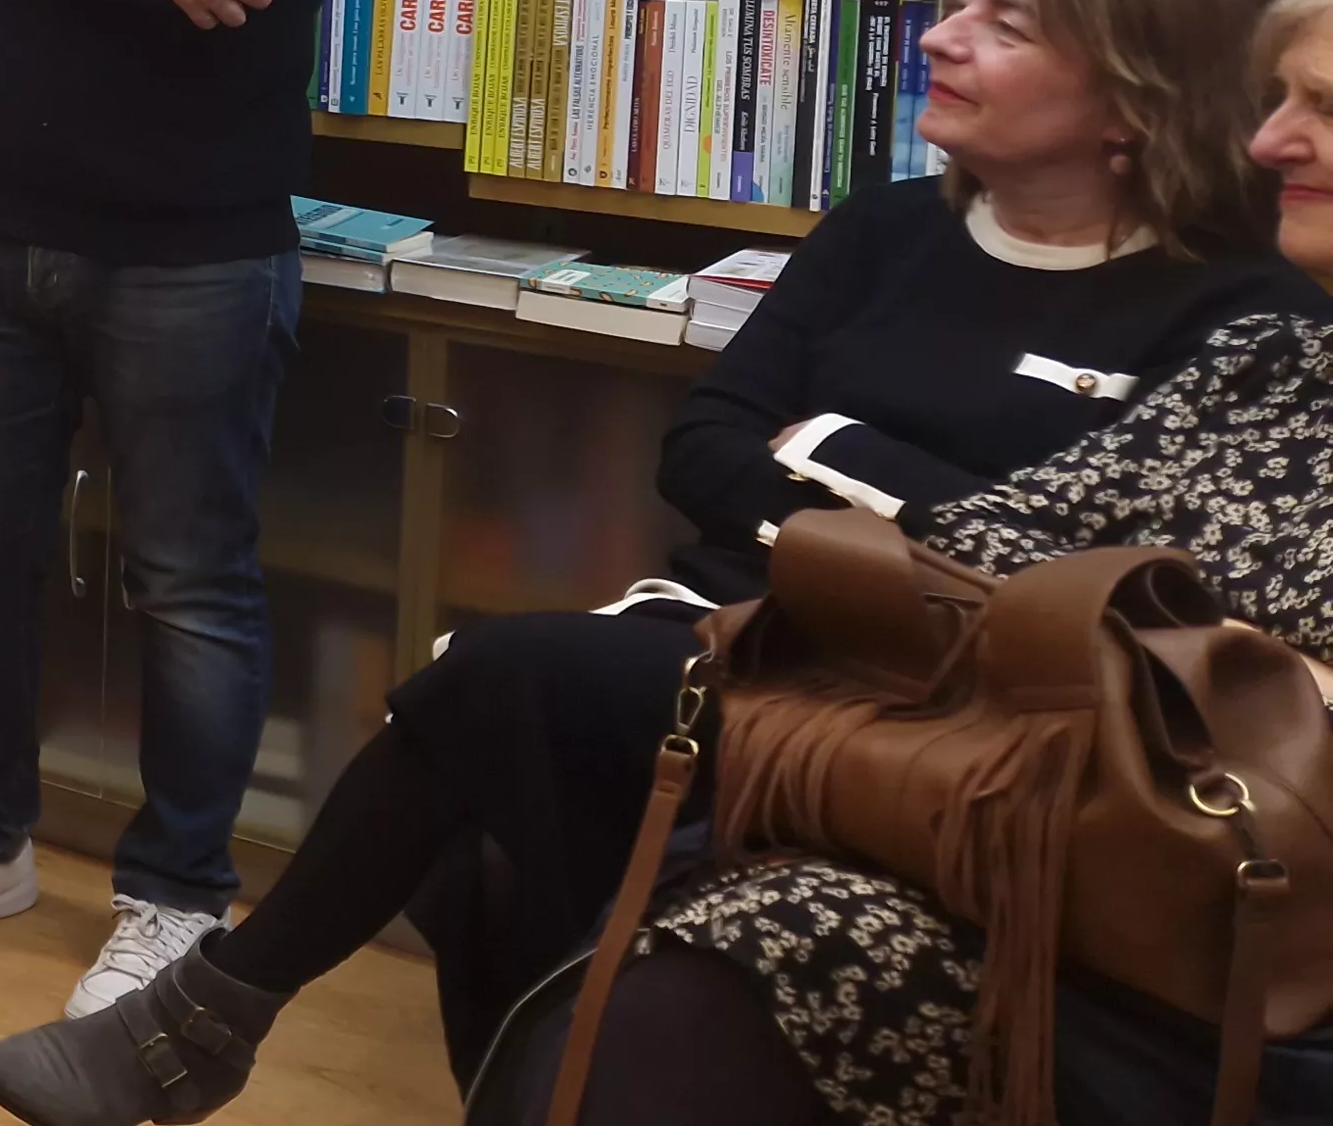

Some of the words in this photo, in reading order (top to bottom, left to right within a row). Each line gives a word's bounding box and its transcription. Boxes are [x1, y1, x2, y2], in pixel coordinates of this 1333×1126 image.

[553, 4, 570, 46] ESPINOSA
[782, 14, 797, 66] Altamente
[574, 45, 585, 85] ALTERNATIVAS
[589, 35, 600, 85] EMOCIONAL
[743, 37, 754, 56] TUS
[573, 87, 583, 107] FALSAS
[664, 89, 673, 105] DEL
[665, 70, 674, 87] EGO
[741, 56, 753, 100] SOMBRAS
[780, 69, 795, 110] sensible
[511, 97, 527, 137] ESPINOSA
[529, 98, 545, 138] ESPINOSA
[572, 108, 582, 120] LAS
[586, 88, 596, 130] HERENCIA
[683, 76, 698, 133] DIGNIDAD
[662, 106, 673, 150] QUIMERAS
[509, 139, 524, 168] ALBERT
[527, 140, 542, 170] ALBERT
